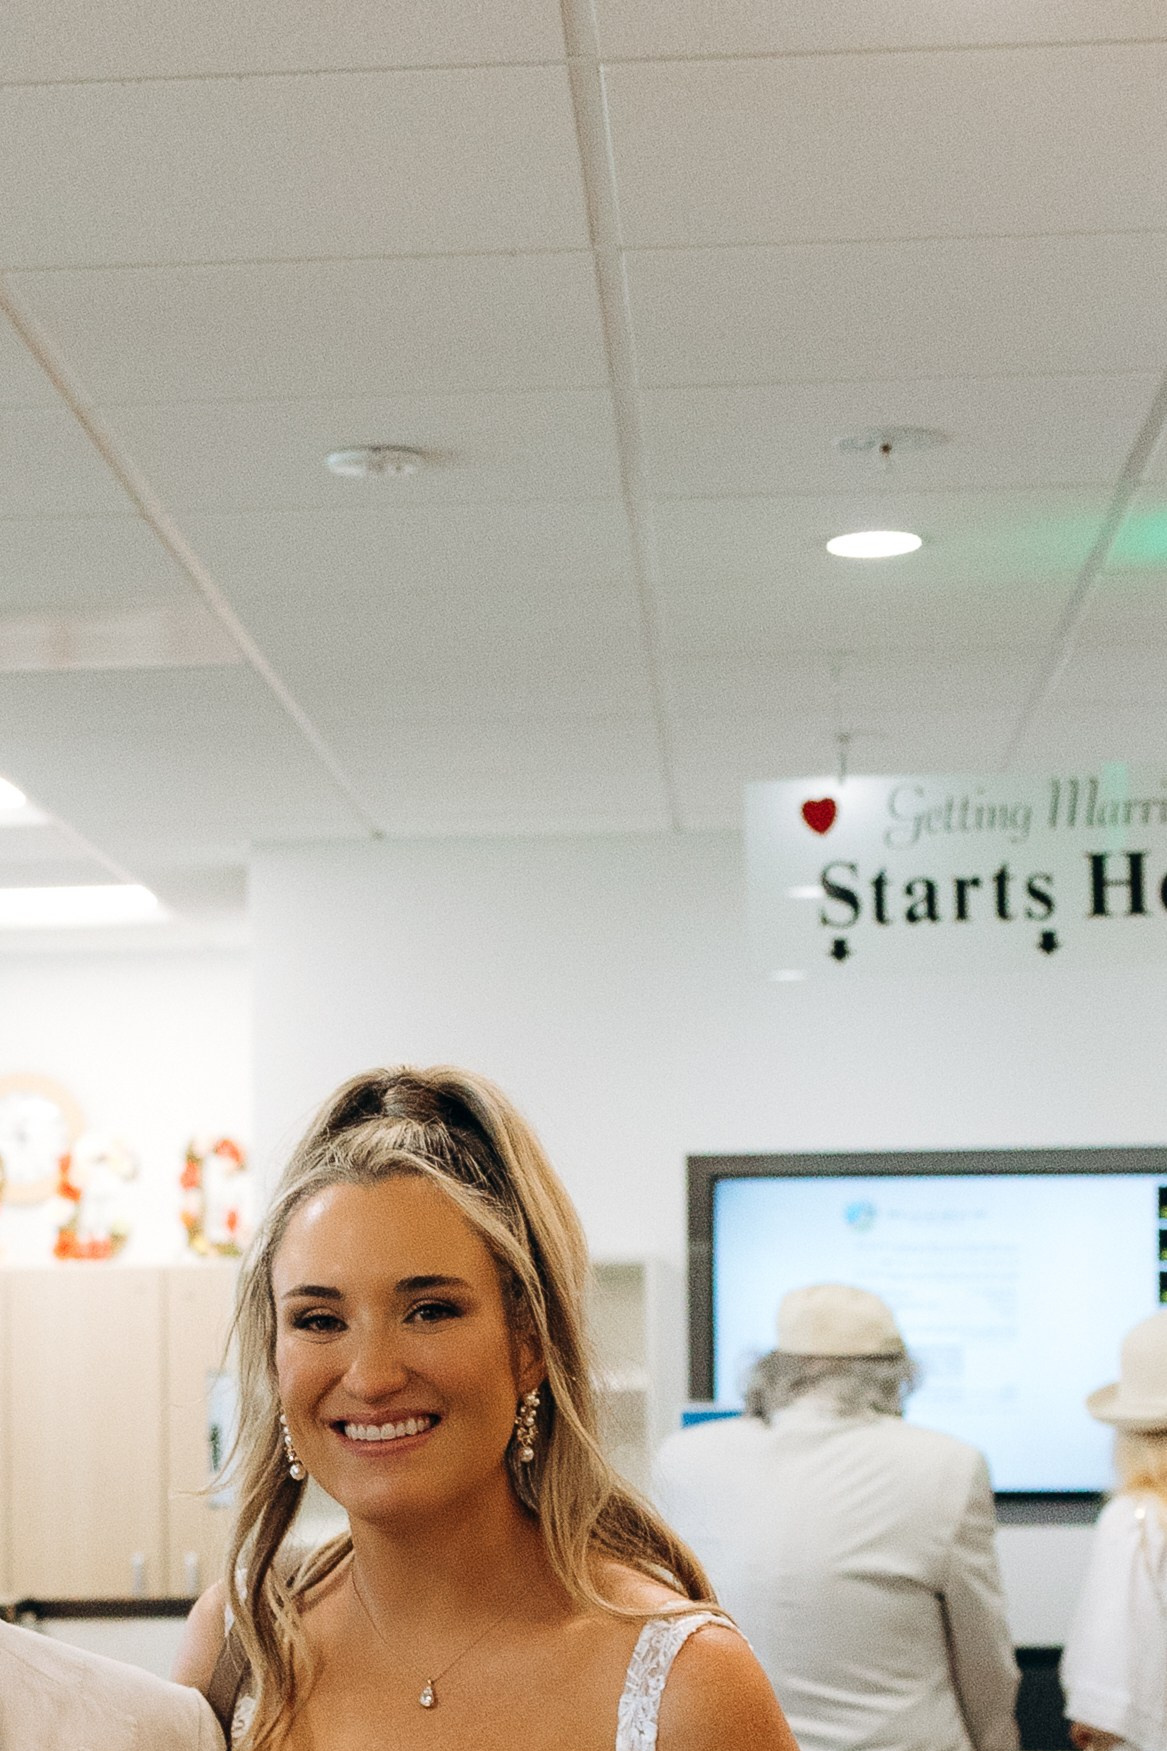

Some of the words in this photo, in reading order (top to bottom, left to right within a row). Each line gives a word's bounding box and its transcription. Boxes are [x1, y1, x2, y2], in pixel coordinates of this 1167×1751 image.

[883, 782, 1032, 849] Getting
[819, 860, 1056, 928] Starts
[1085, 850, 1167, 918] H
